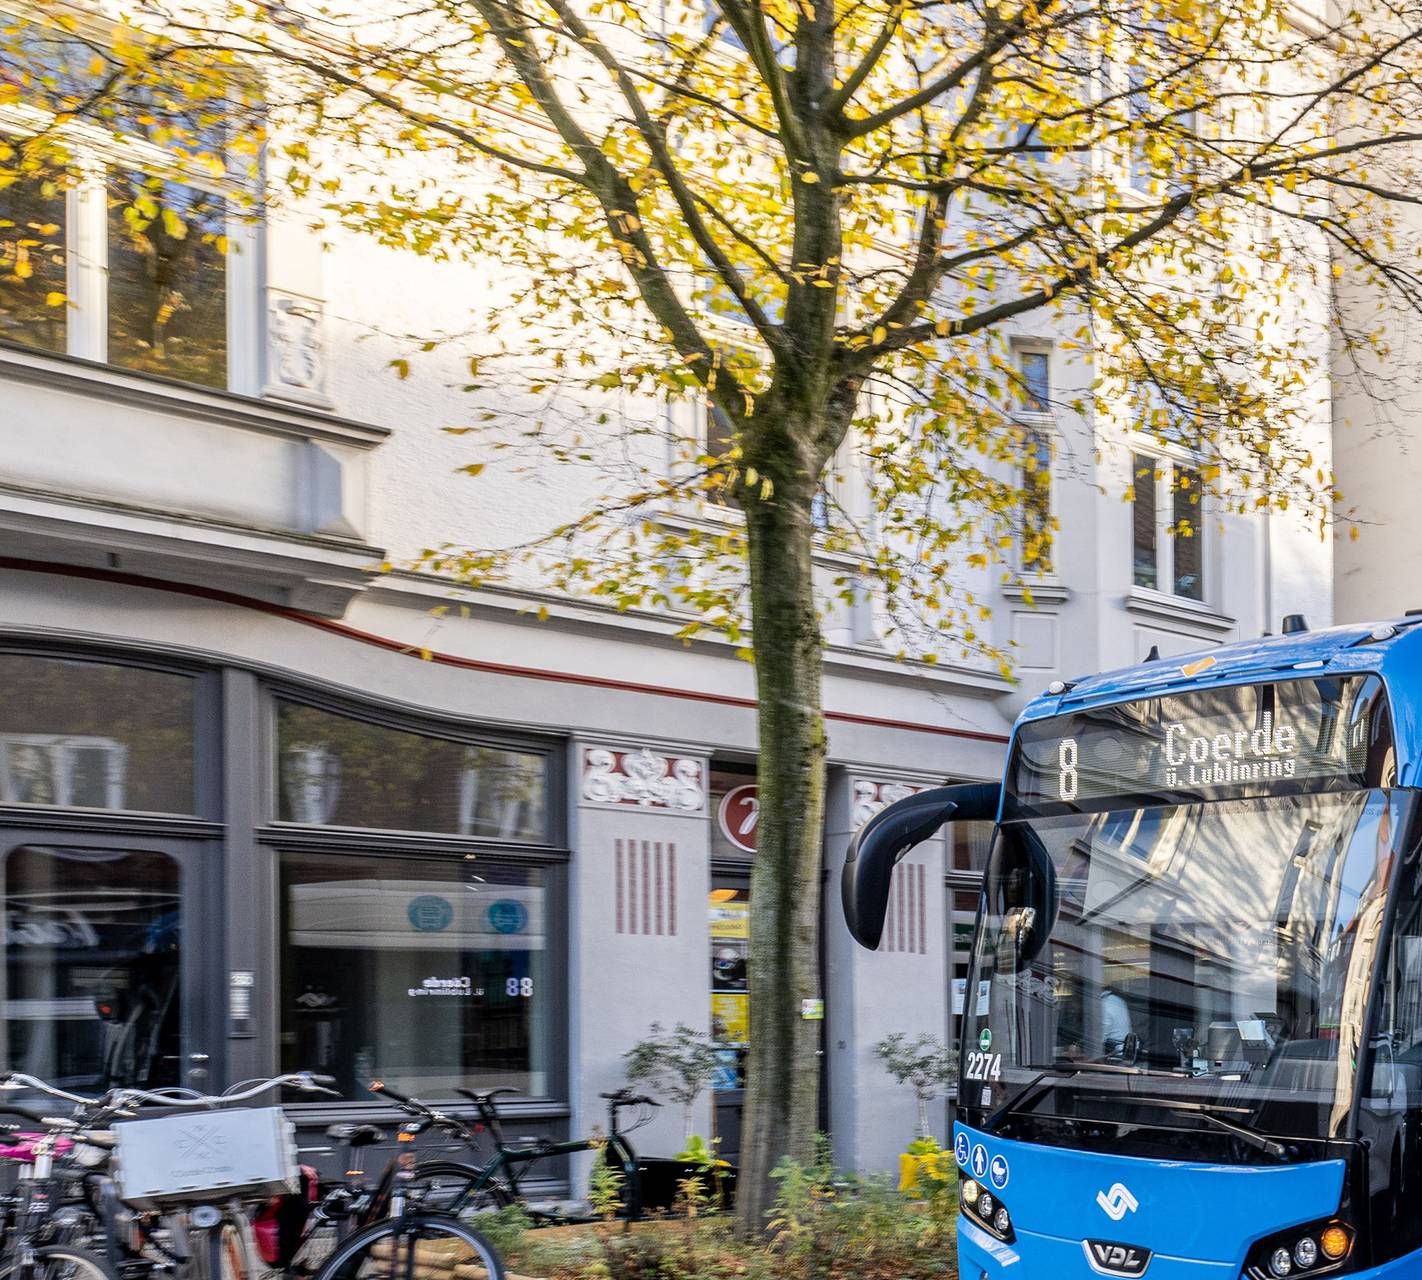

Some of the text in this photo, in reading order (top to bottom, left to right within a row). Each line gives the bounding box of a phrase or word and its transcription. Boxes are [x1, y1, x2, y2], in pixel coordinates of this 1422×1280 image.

[1165, 711, 1296, 767] Coerde
[1059, 738, 1078, 801] 8
[1166, 756, 1296, 788] ü. Lublinring
[966, 1051, 1002, 1081] 2274
[1094, 1244, 1141, 1269] VDL
